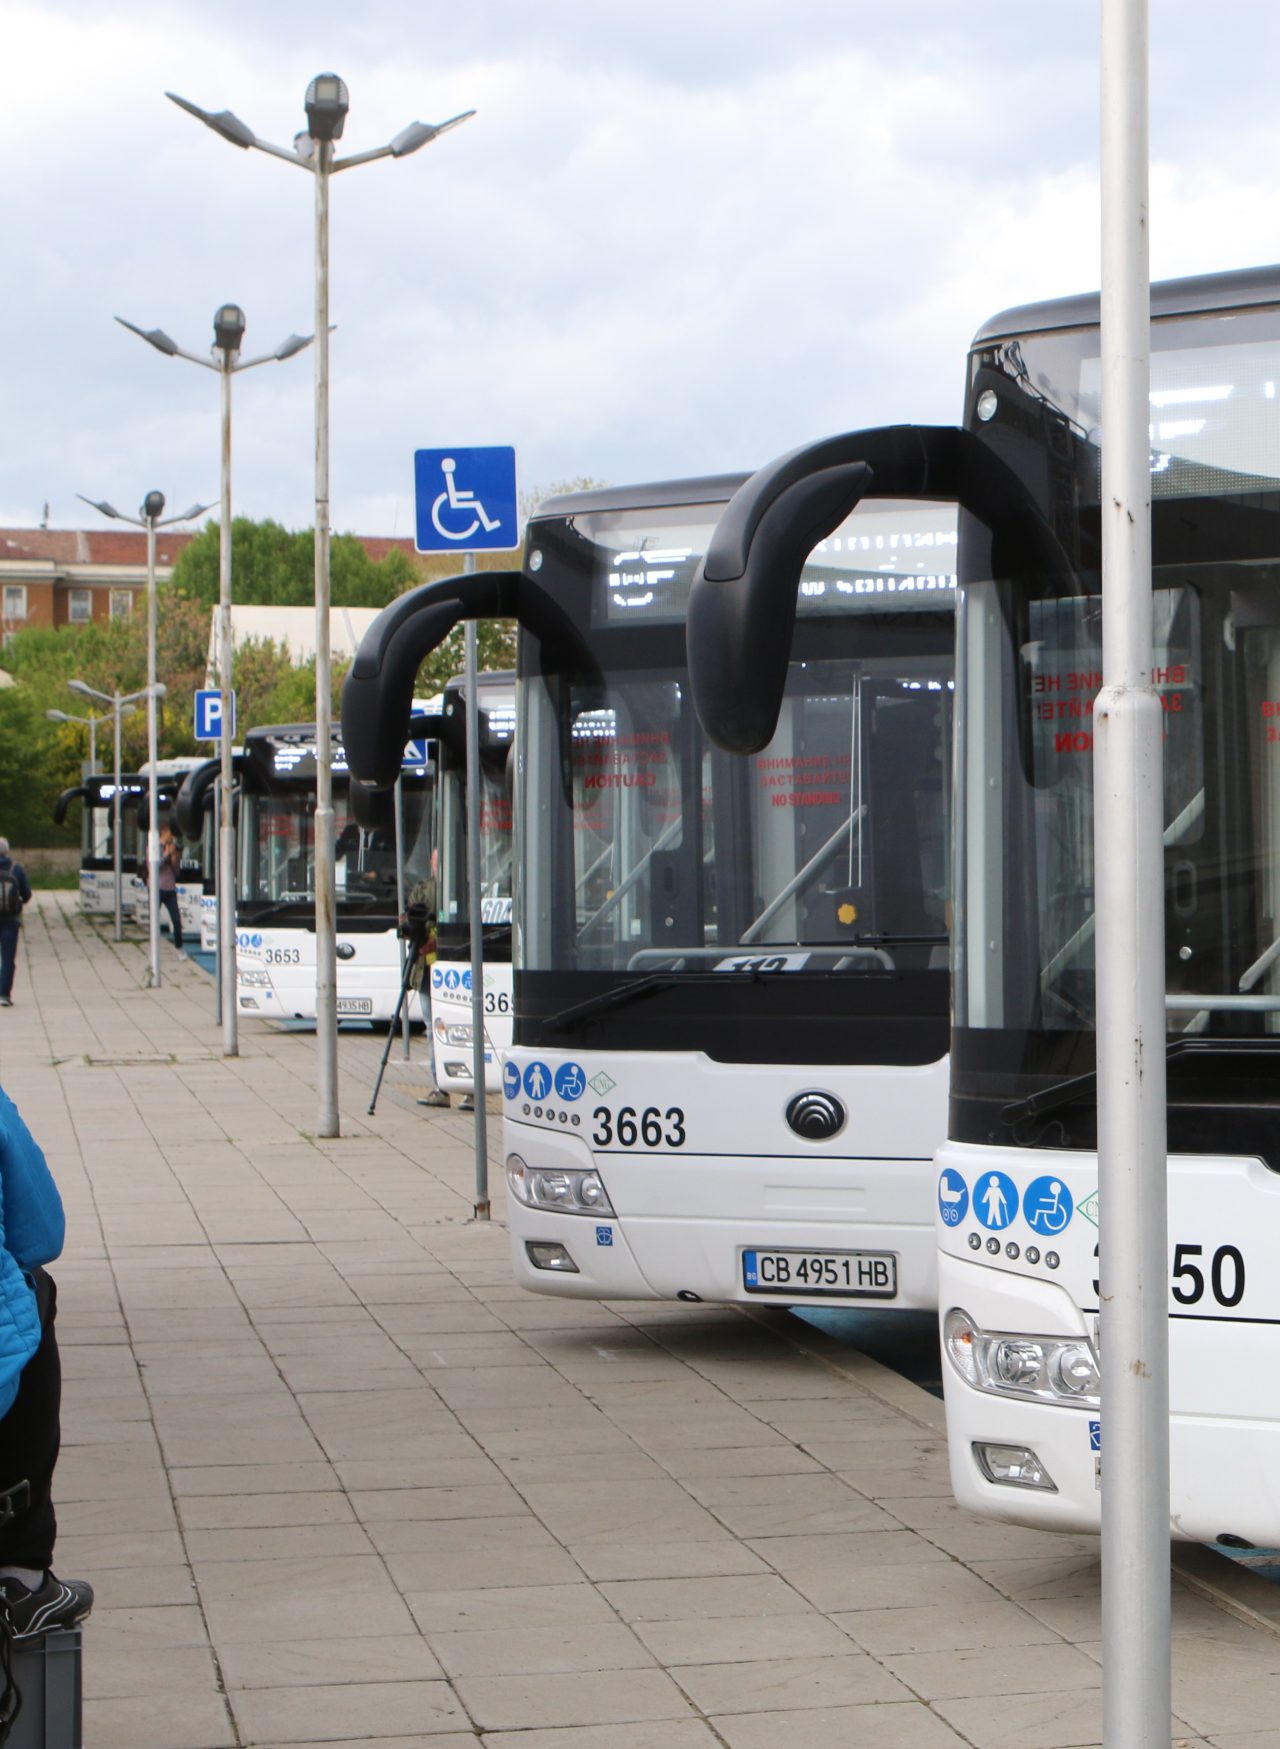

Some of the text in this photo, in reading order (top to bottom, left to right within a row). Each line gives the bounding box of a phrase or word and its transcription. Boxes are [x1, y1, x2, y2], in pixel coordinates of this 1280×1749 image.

[205, 697, 224, 732] P
[772, 794, 787, 806] NO
[265, 948, 300, 963] 3653
[593, 1106, 686, 1147] 3663
[761, 1257, 790, 1282] CB
[796, 1258, 850, 1285] 4951
[858, 1260, 889, 1286] HB
